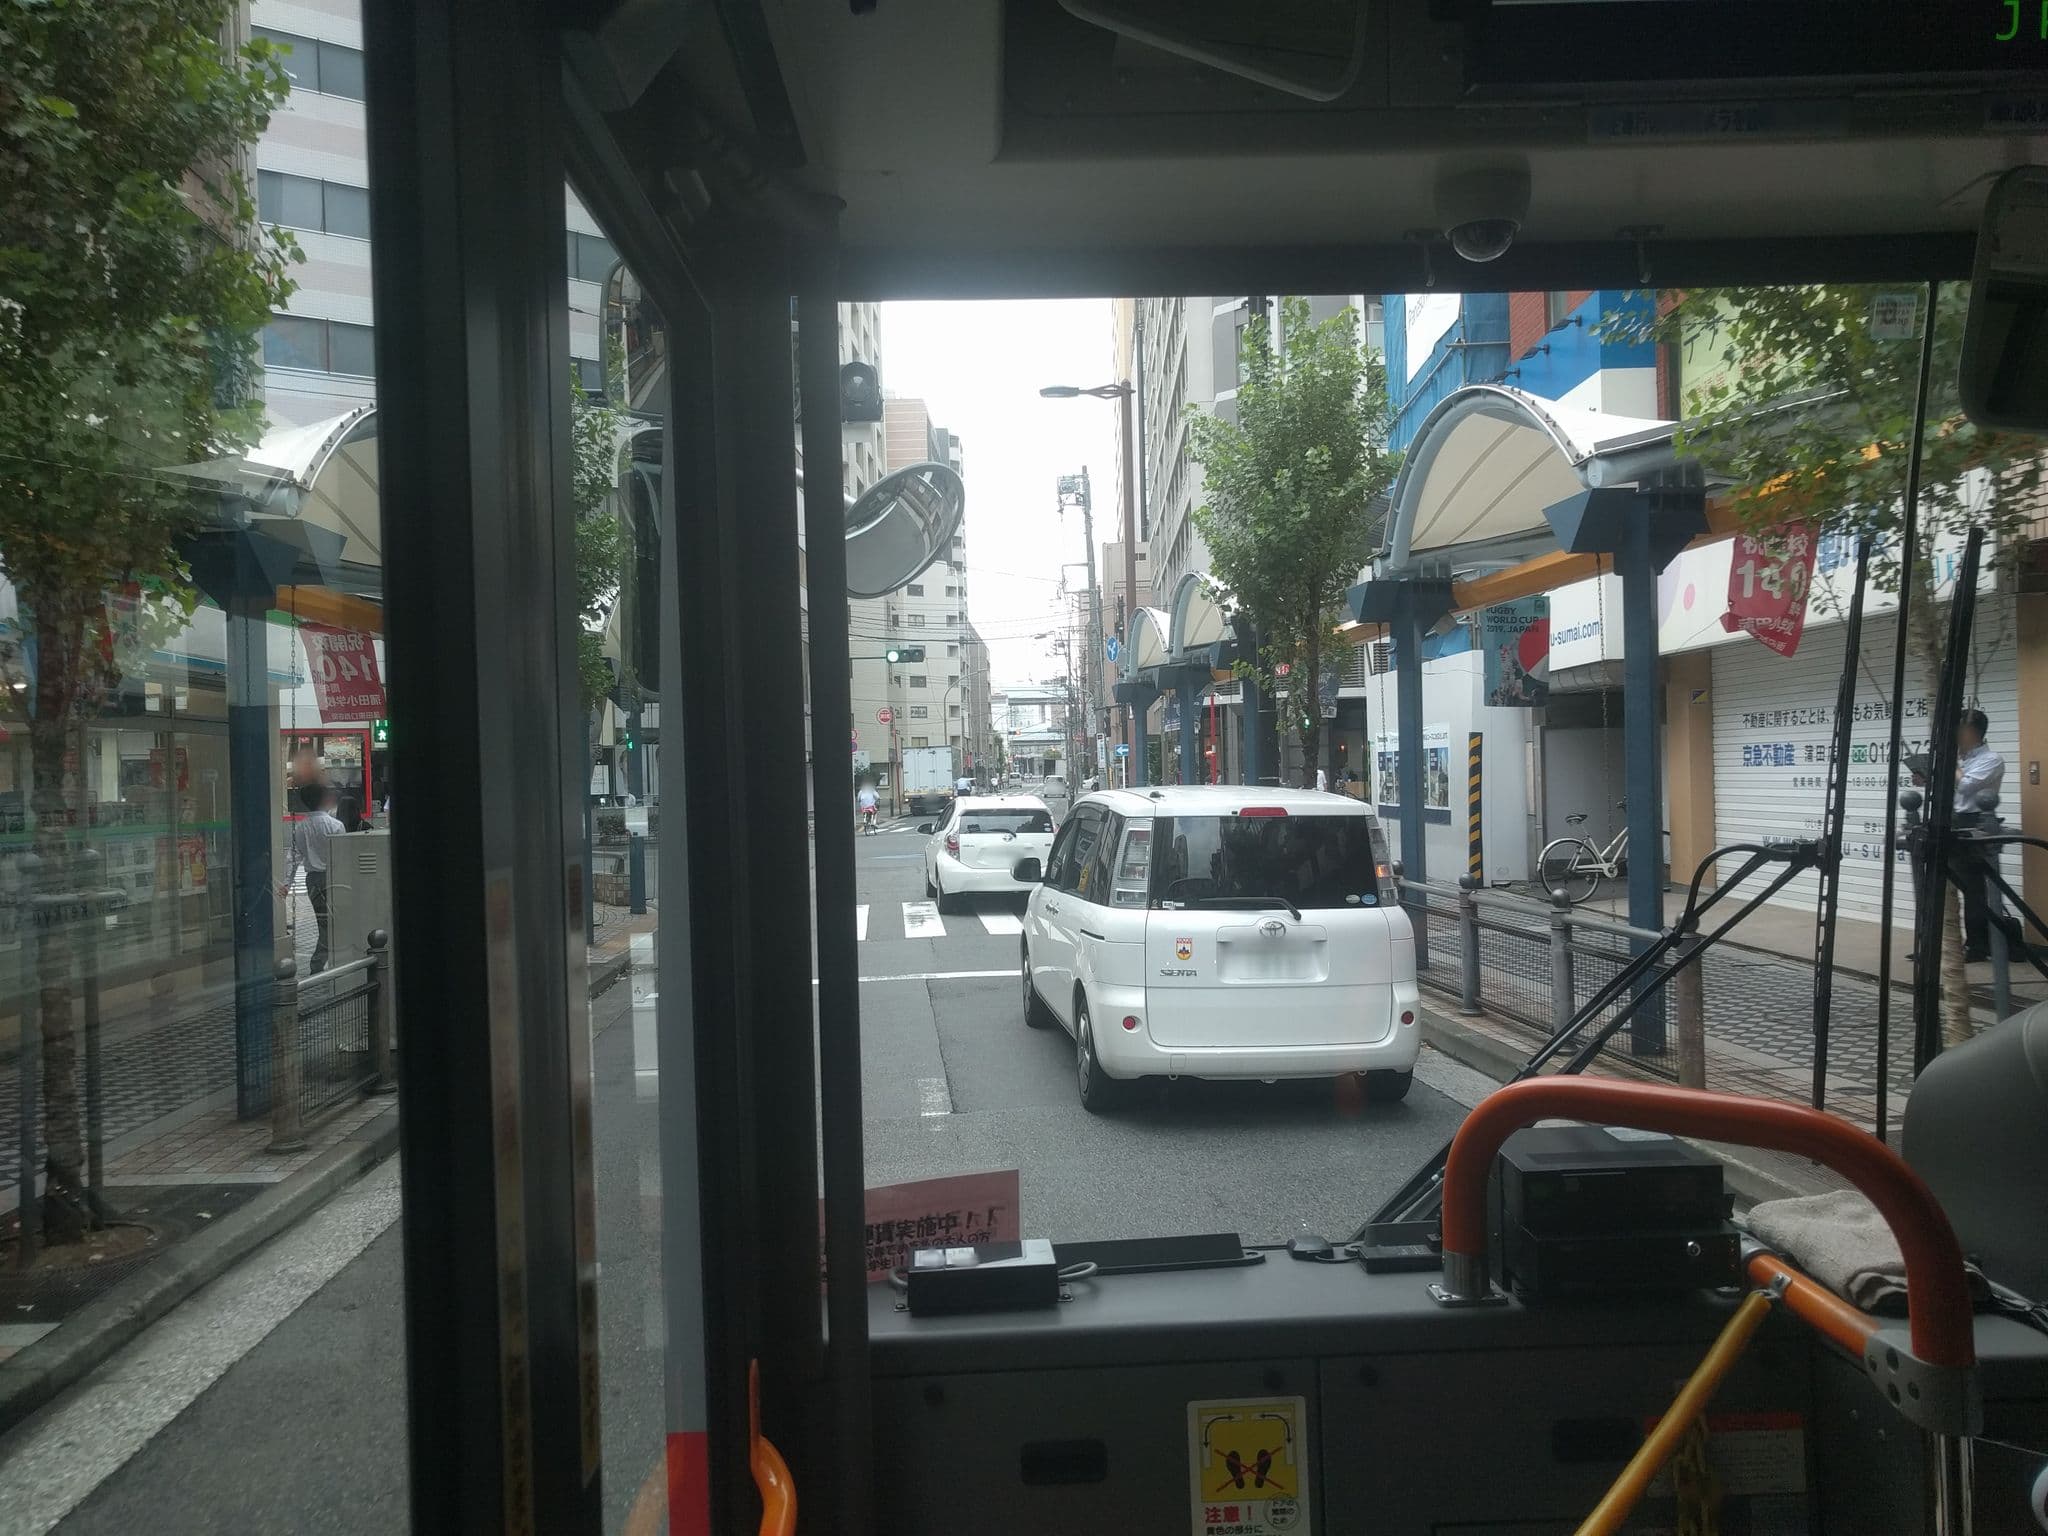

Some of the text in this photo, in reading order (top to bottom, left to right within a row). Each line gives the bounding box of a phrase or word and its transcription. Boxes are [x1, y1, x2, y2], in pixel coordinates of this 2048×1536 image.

[1737, 559, 1808, 601] 140
[1487, 615, 1540, 625] WORLD CUP
[1507, 624, 1540, 633] JAPAN
[1550, 620, 1601, 647] u-sumai.com
[1742, 742, 1796, 767] 京急不動産
[1205, 1505, 1252, 1523] 注意！
